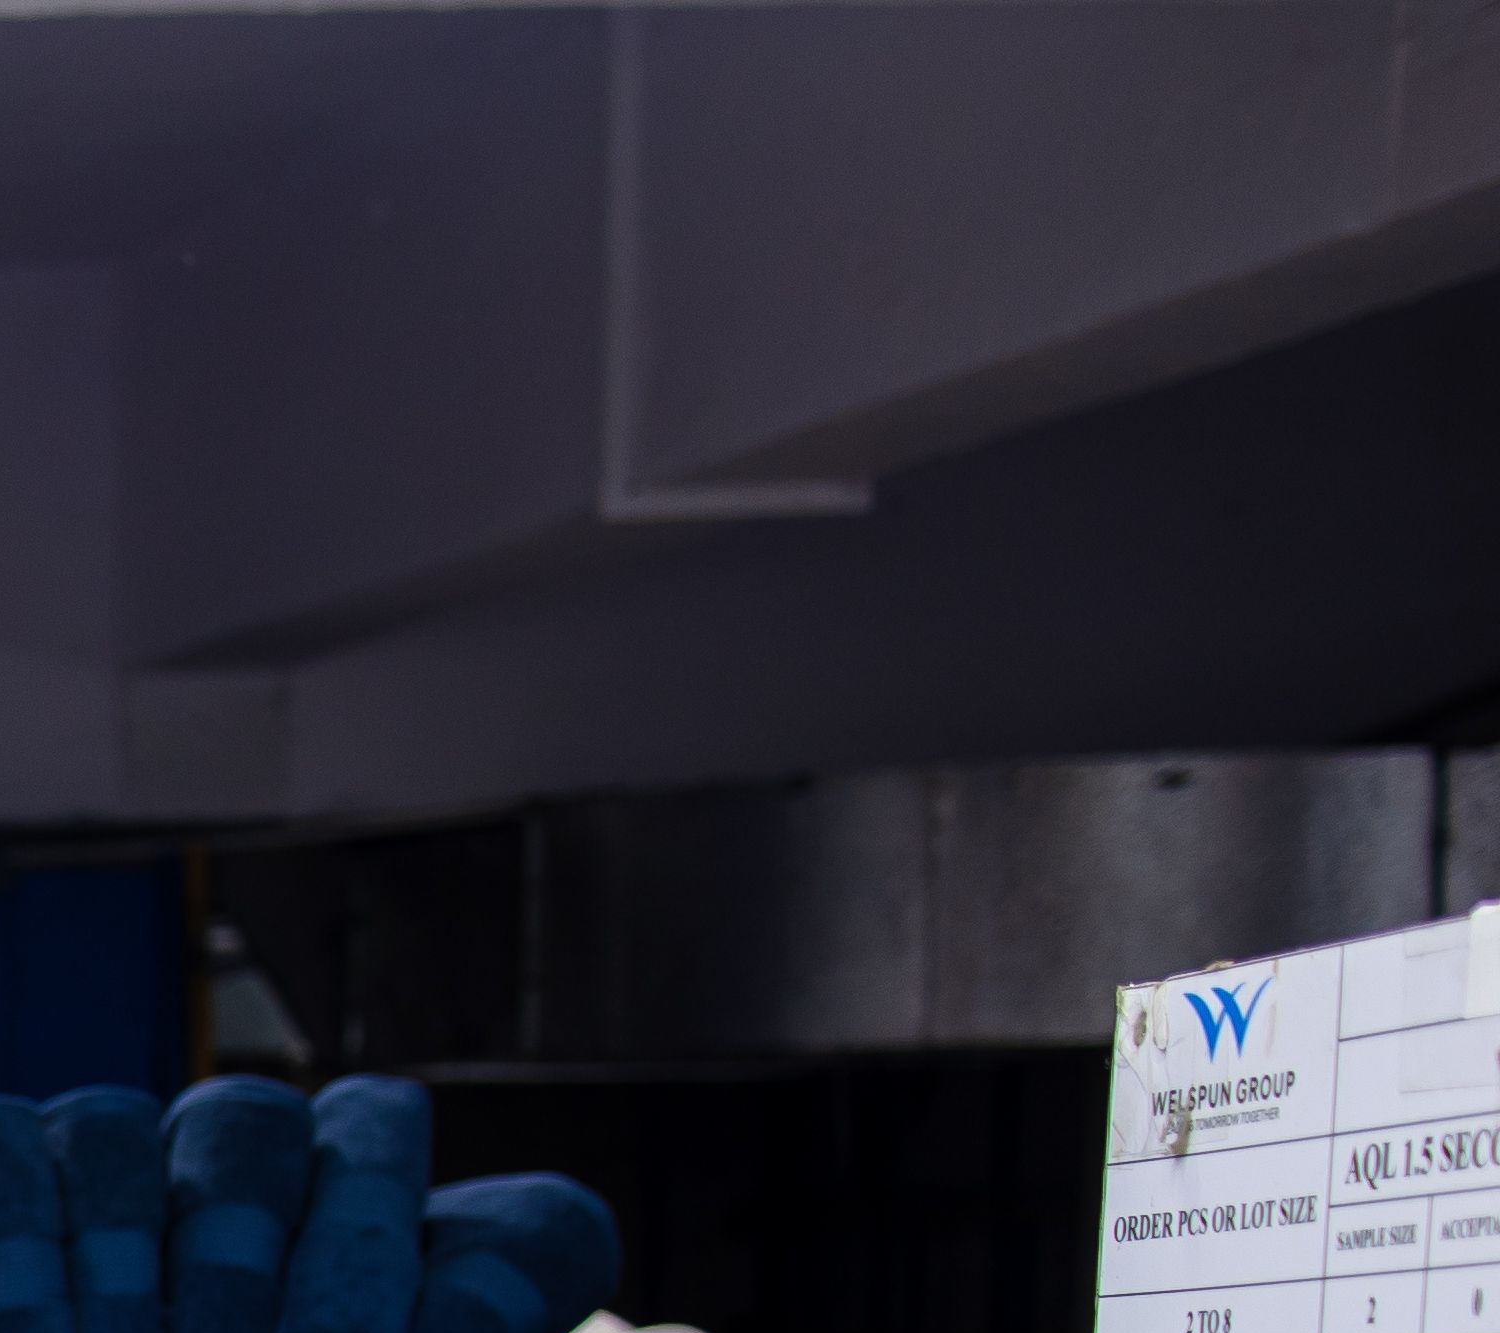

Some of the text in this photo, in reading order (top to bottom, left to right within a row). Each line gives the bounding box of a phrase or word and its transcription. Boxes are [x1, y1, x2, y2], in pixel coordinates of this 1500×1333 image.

[1152, 1070, 1296, 1117] WELSPUN GROUP
[1345, 1143, 1397, 1190] AQL
[1403, 1136, 1434, 1177] 1.5
[1114, 1195, 1318, 1243] ORDER PCS OR LOT SIZE
[1336, 1224, 1418, 1251] SAMPLE SIZE
[1367, 1297, 1376, 1324] 2
[1472, 1287, 1483, 1316] 0
[1223, 1309, 1232, 1333] 8
